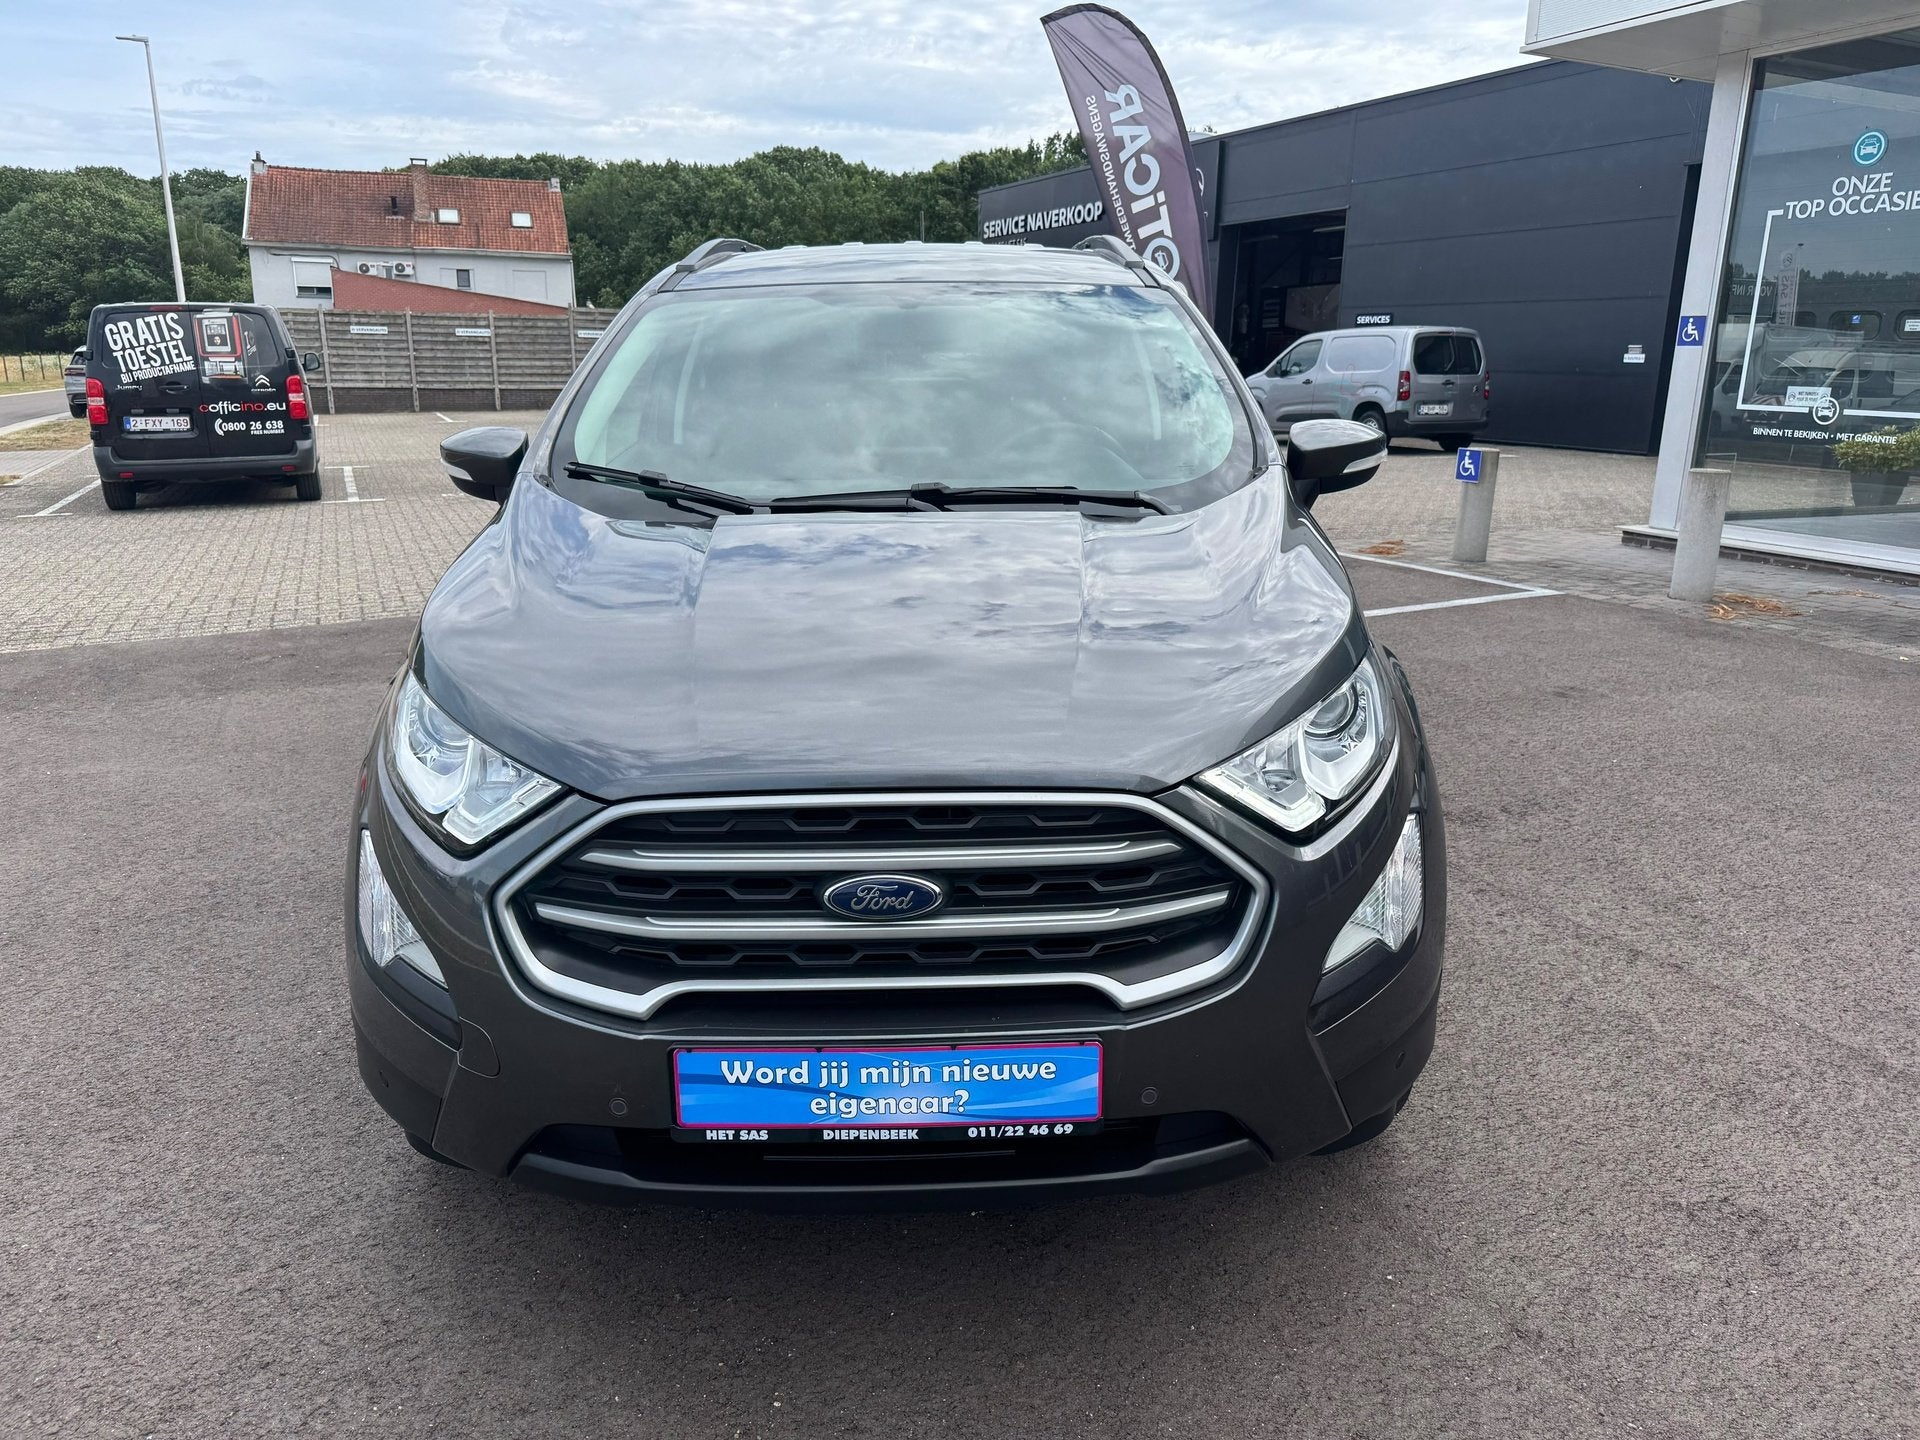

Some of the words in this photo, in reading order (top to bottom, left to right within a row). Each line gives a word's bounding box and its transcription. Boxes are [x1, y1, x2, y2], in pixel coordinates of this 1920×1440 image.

[1832, 172, 1893, 196] ONZE
[983, 214, 1025, 239] SERVICE
[1027, 201, 1103, 232] NAVERKOOP
[1785, 199, 1825, 219] TOP
[1356, 315, 1391, 324] SERVICES
[104, 312, 184, 351] GRATIS
[112, 340, 193, 373] TOESTEL
[132, 360, 197, 381] PRODUCTAFNAME
[199, 401, 286, 415] cofficino.eu
[221, 421, 247, 432] 0800
[249, 421, 263, 431] 26
[265, 420, 284, 430] 638
[1752, 427, 1783, 438] BINNEN
[1784, 429, 1793, 438] TE
[1793, 430, 1830, 440] BEKIJKEN
[1836, 432, 1854, 442] MET
[1854, 433, 1898, 445] GARANTIE
[851, 884, 915, 910] Ford
[720, 1060, 809, 1085] Word
[818, 1060, 849, 1088] jij
[859, 1058, 932, 1087] mijn
[941, 1058, 1057, 1083] nieuwe
[809, 1089, 970, 1118] eigenaar?
[706, 1129, 736, 1141] HET
[739, 1129, 769, 1141] SAS
[823, 1129, 919, 1141] DIEPENBEEK
[967, 1125, 1024, 1139] 011/22
[1029, 1124, 1050, 1136] 46
[1053, 1123, 1074, 1135] 69
